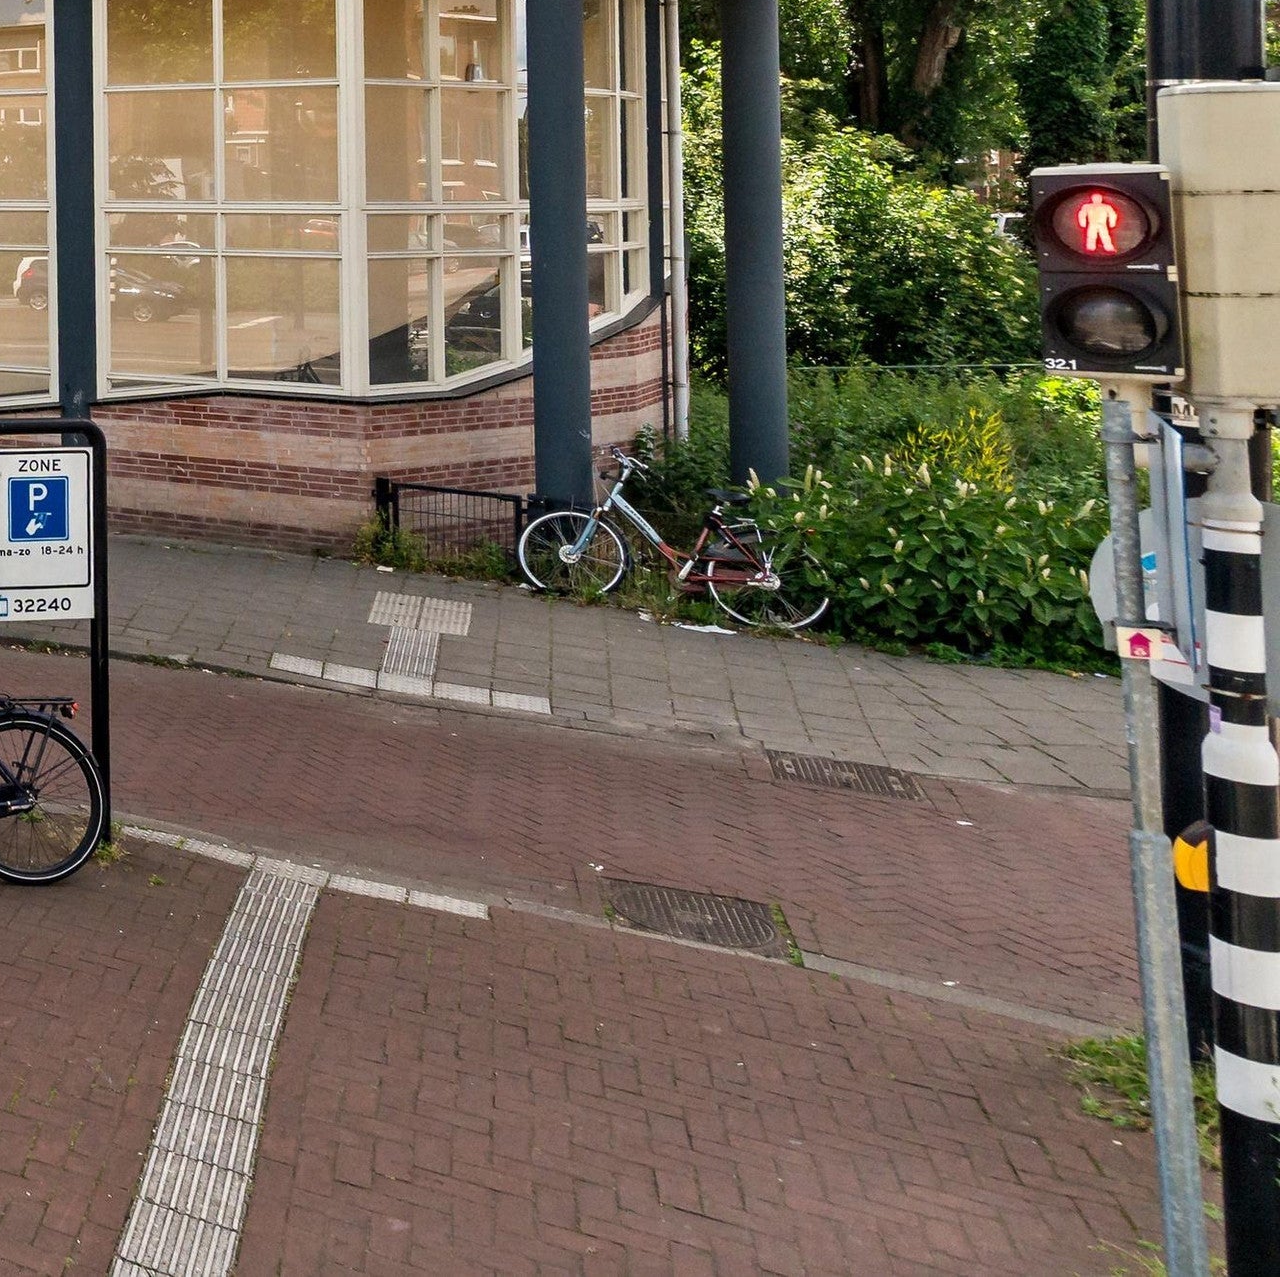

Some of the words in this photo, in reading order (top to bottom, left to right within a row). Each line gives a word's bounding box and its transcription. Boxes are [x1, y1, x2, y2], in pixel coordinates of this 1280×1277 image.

[18, 459, 61, 472] ZONE
[28, 483, 48, 511] P
[41, 546, 73, 555] 18-24
[77, 545, 84, 554] h
[13, 598, 72, 612] 32240
